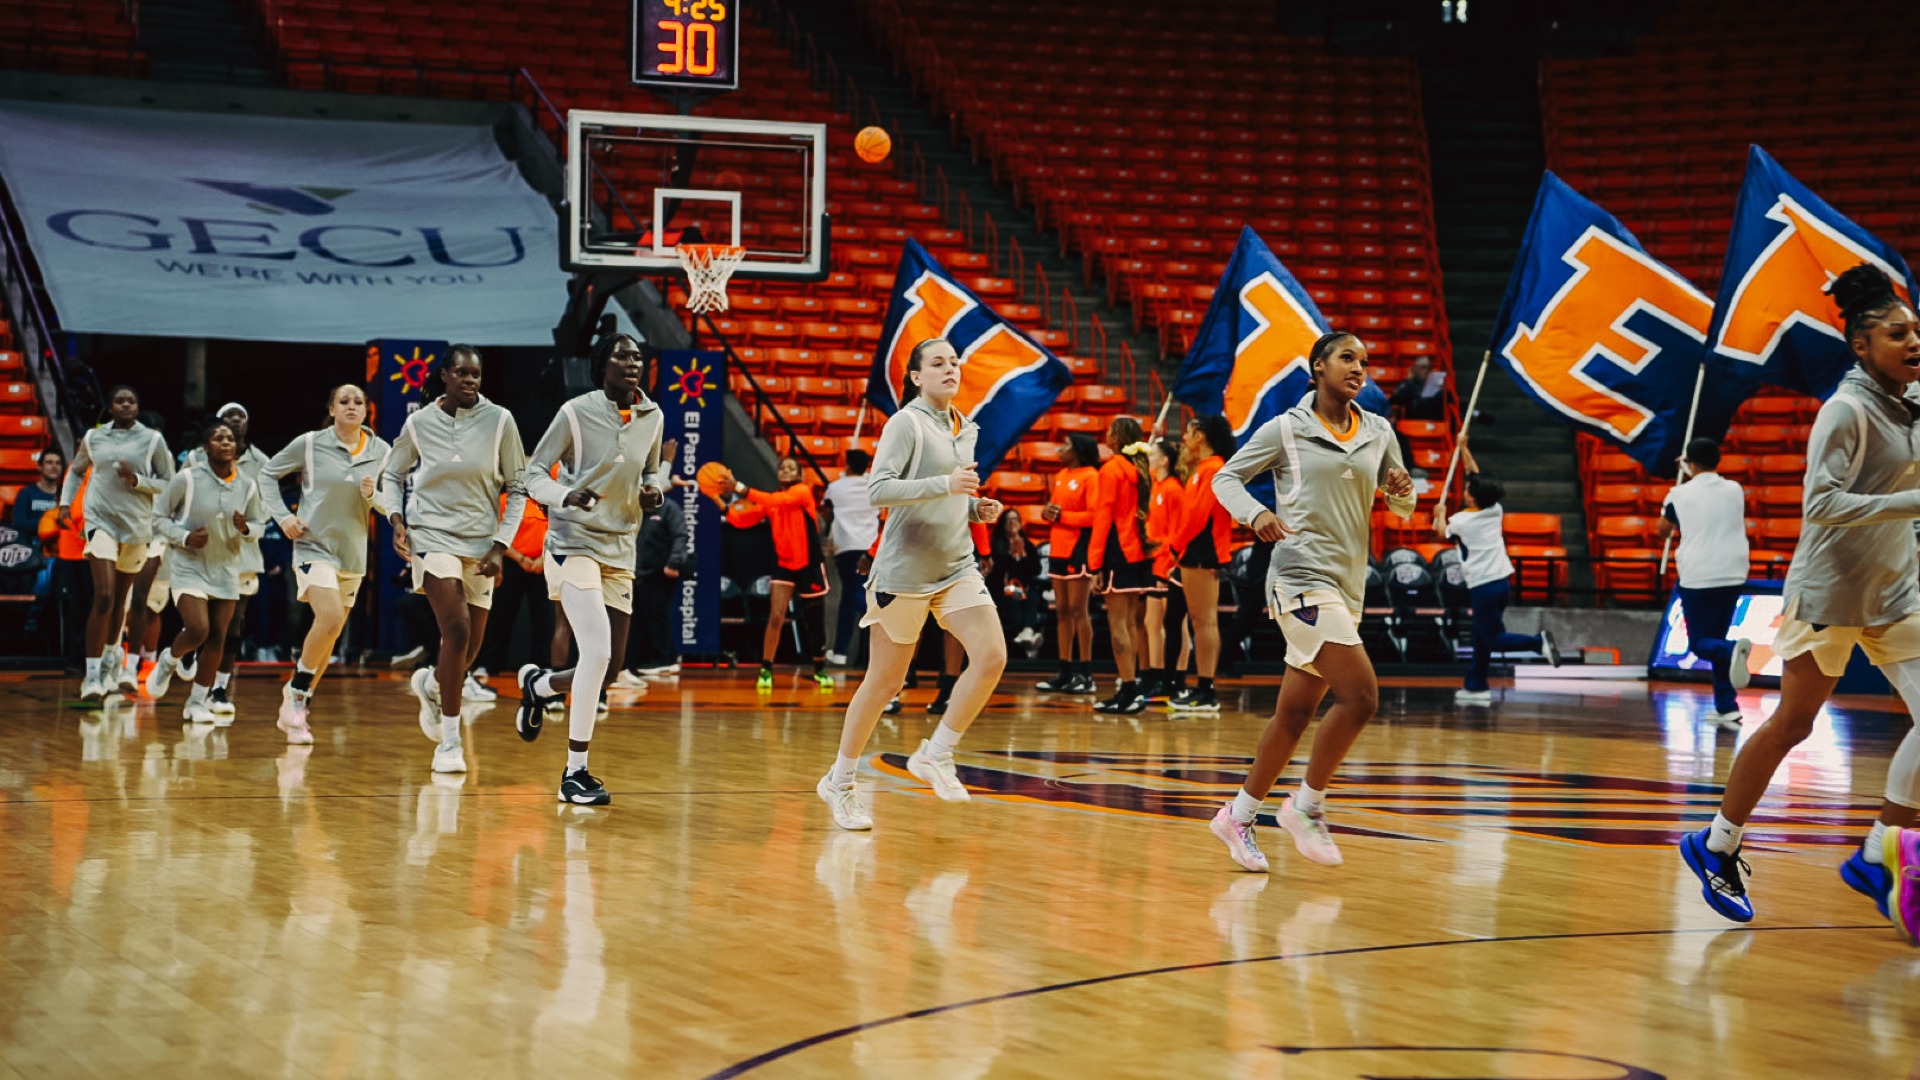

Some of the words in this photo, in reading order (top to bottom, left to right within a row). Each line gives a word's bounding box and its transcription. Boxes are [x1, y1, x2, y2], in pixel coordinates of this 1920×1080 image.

[662, 0, 726, 21] 4:25
[657, 20, 716, 75] 30
[46, 209, 525, 268] GECU
[156, 258, 289, 284] WE'RE
[296, 271, 392, 286] WITH
[405, 273, 484, 287] YOU
[1502, 224, 1716, 444] E
[684, 411, 700, 428] El
[683, 432, 700, 475] Paso
